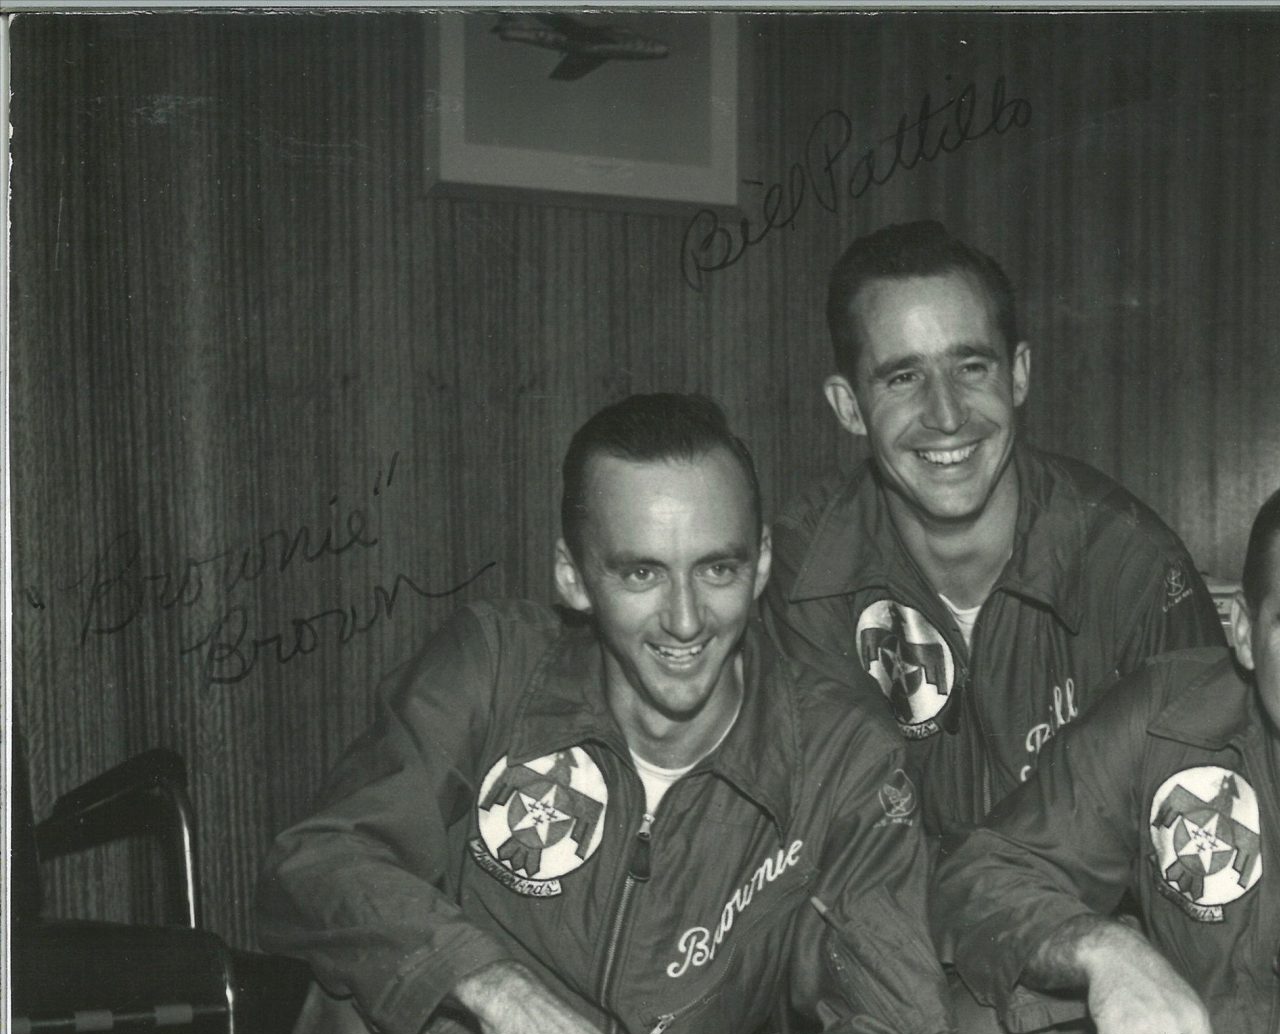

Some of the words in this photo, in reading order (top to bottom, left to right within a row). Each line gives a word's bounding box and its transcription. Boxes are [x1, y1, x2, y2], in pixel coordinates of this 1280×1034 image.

[680, 163, 806, 294] Bill
[181, 561, 496, 685] Brown
[667, 840, 803, 977] Brownie
